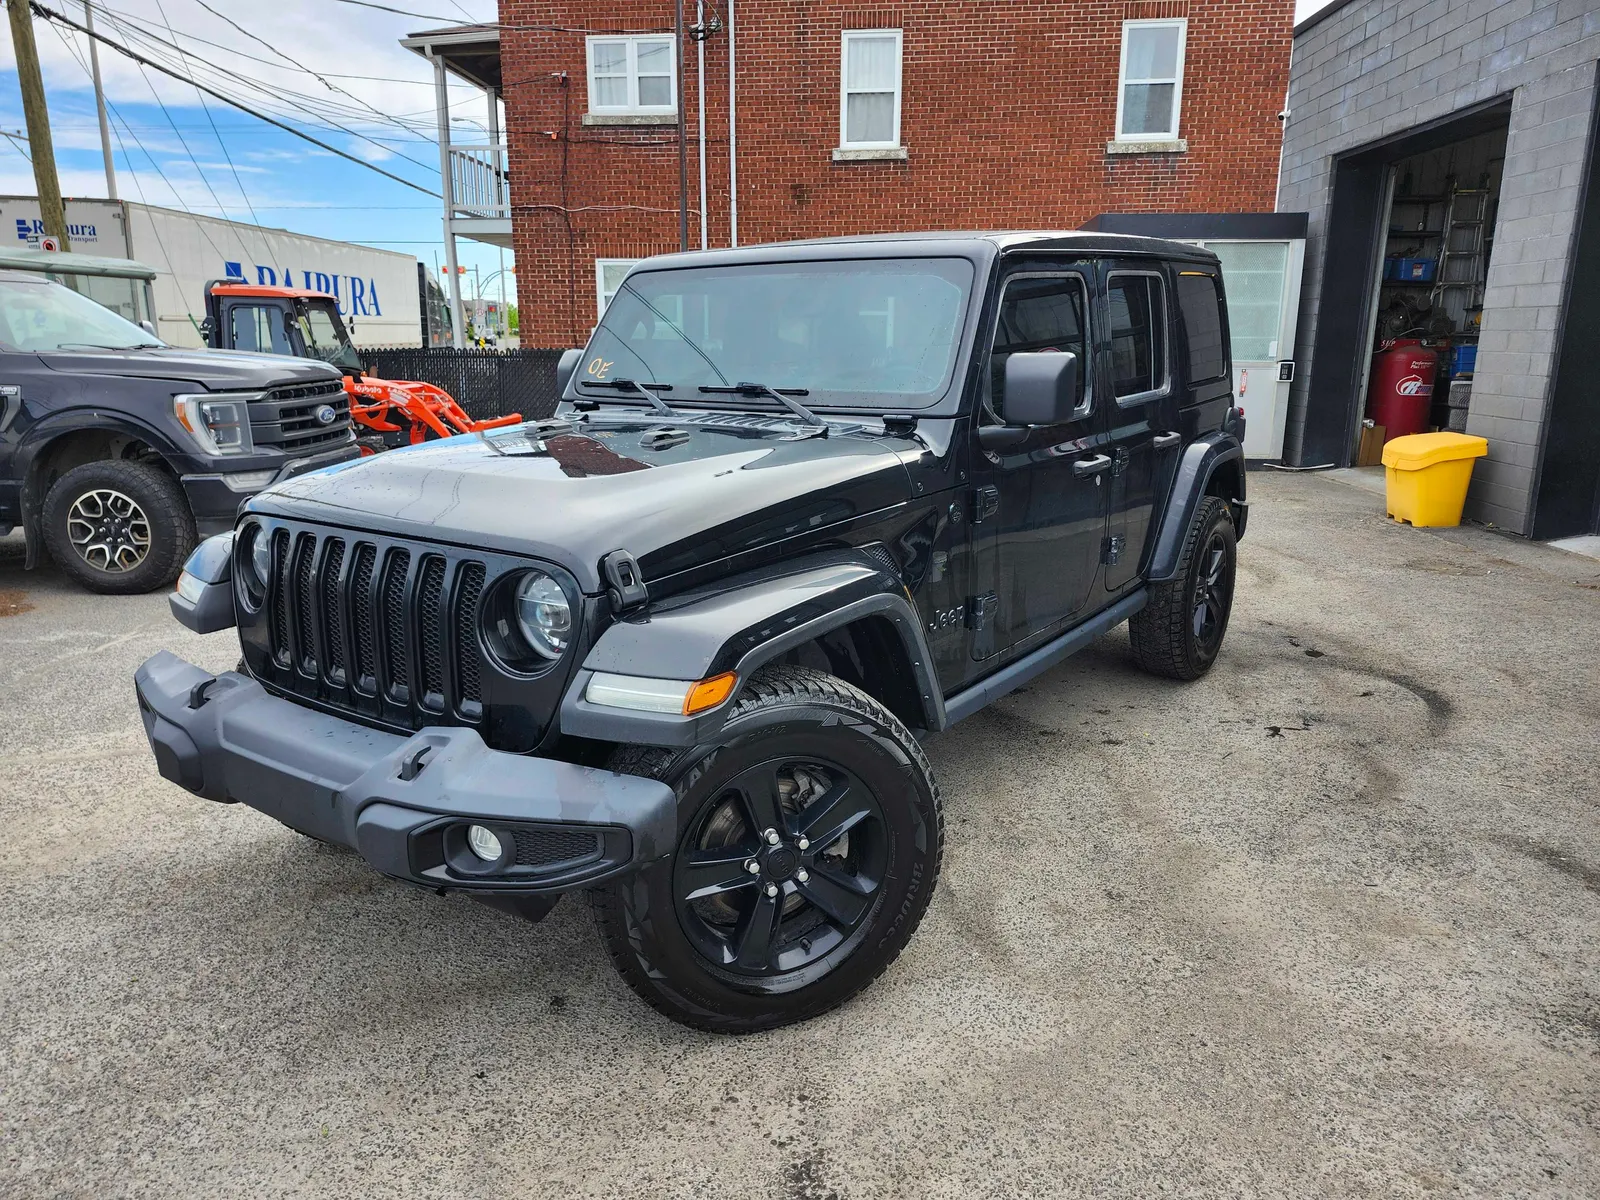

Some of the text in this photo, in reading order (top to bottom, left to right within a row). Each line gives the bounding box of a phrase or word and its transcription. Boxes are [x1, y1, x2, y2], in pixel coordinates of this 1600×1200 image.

[32, 219, 97, 236] Rura
[588, 358, 614, 379] OE
[929, 605, 965, 634] Jeep
